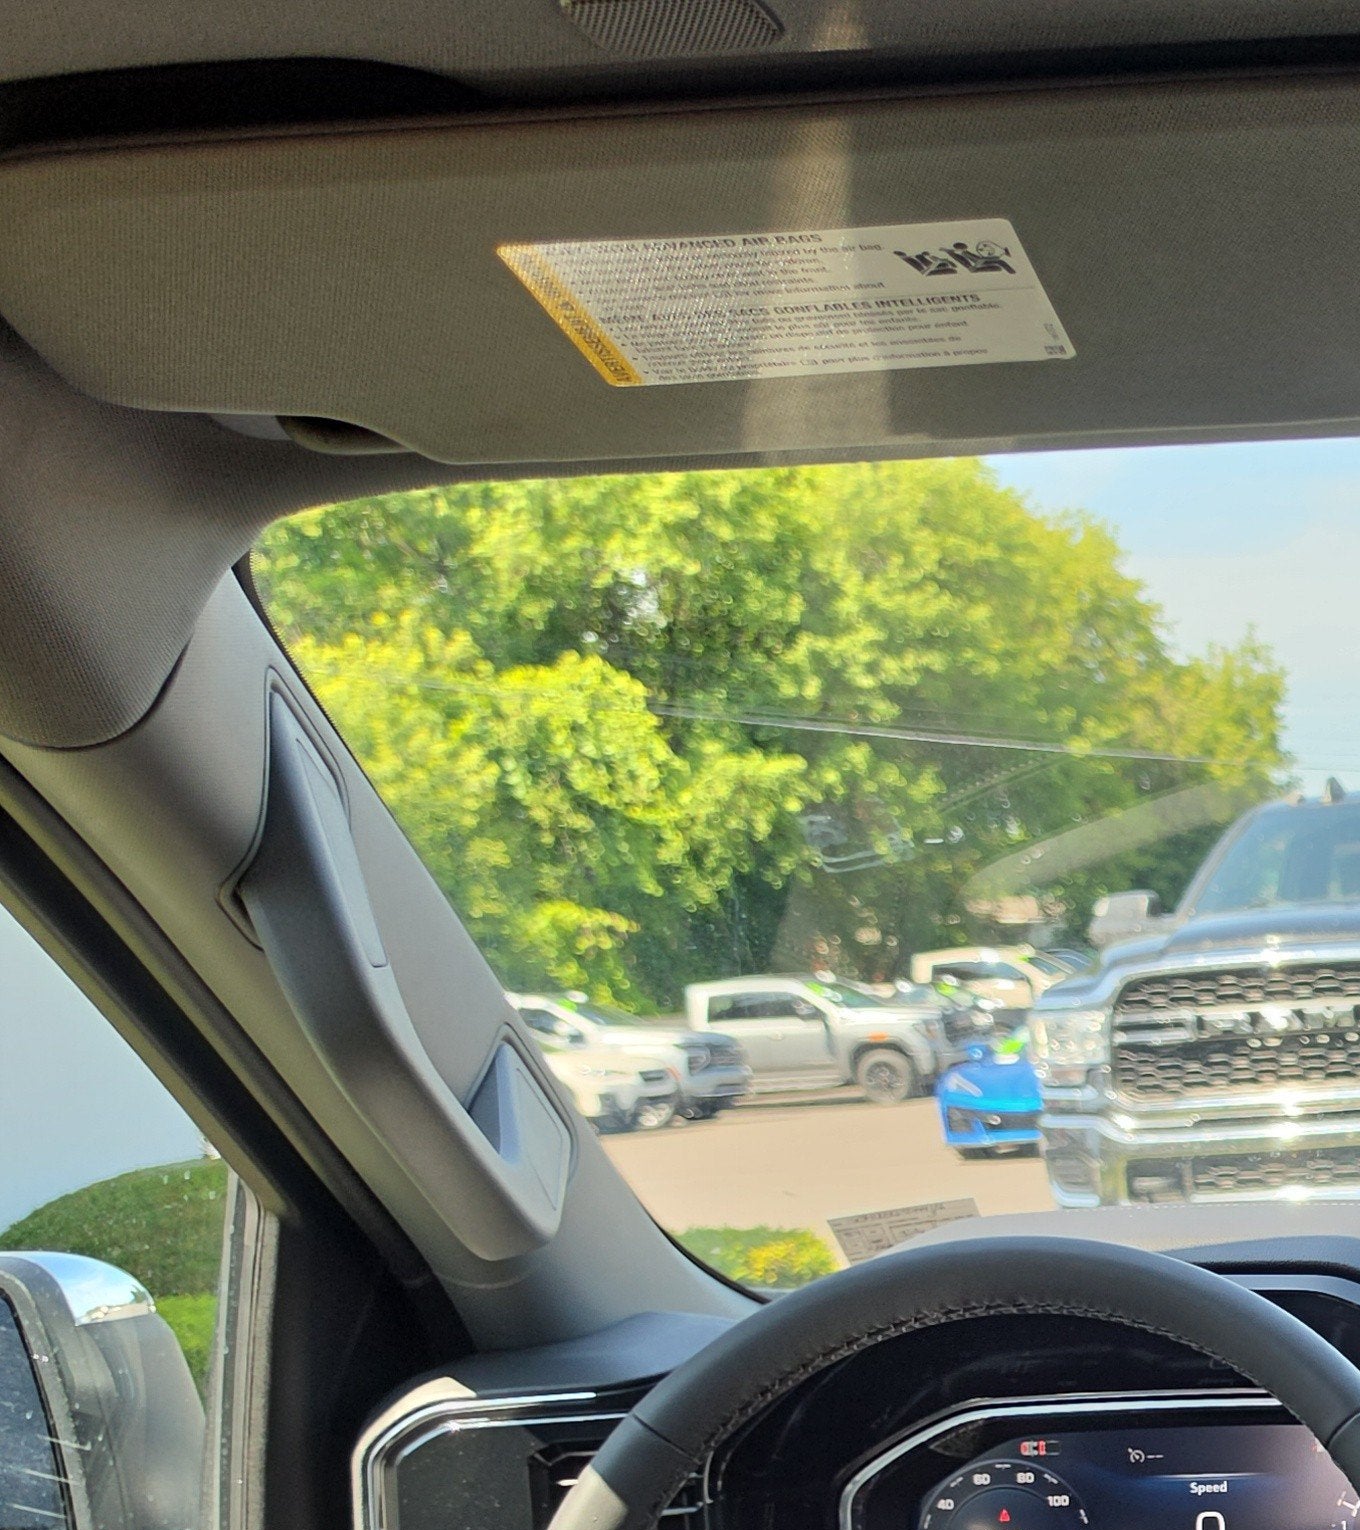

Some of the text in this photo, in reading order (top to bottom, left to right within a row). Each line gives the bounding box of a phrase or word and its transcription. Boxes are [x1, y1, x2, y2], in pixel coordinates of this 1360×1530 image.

[973, 1472, 1035, 1486] 60 80
[1189, 1481, 1228, 1496] Speed
[937, 1499, 954, 1510] 40
[1047, 1495, 1070, 1507] 100
[1341, 1520, 1347, 1530] 1
